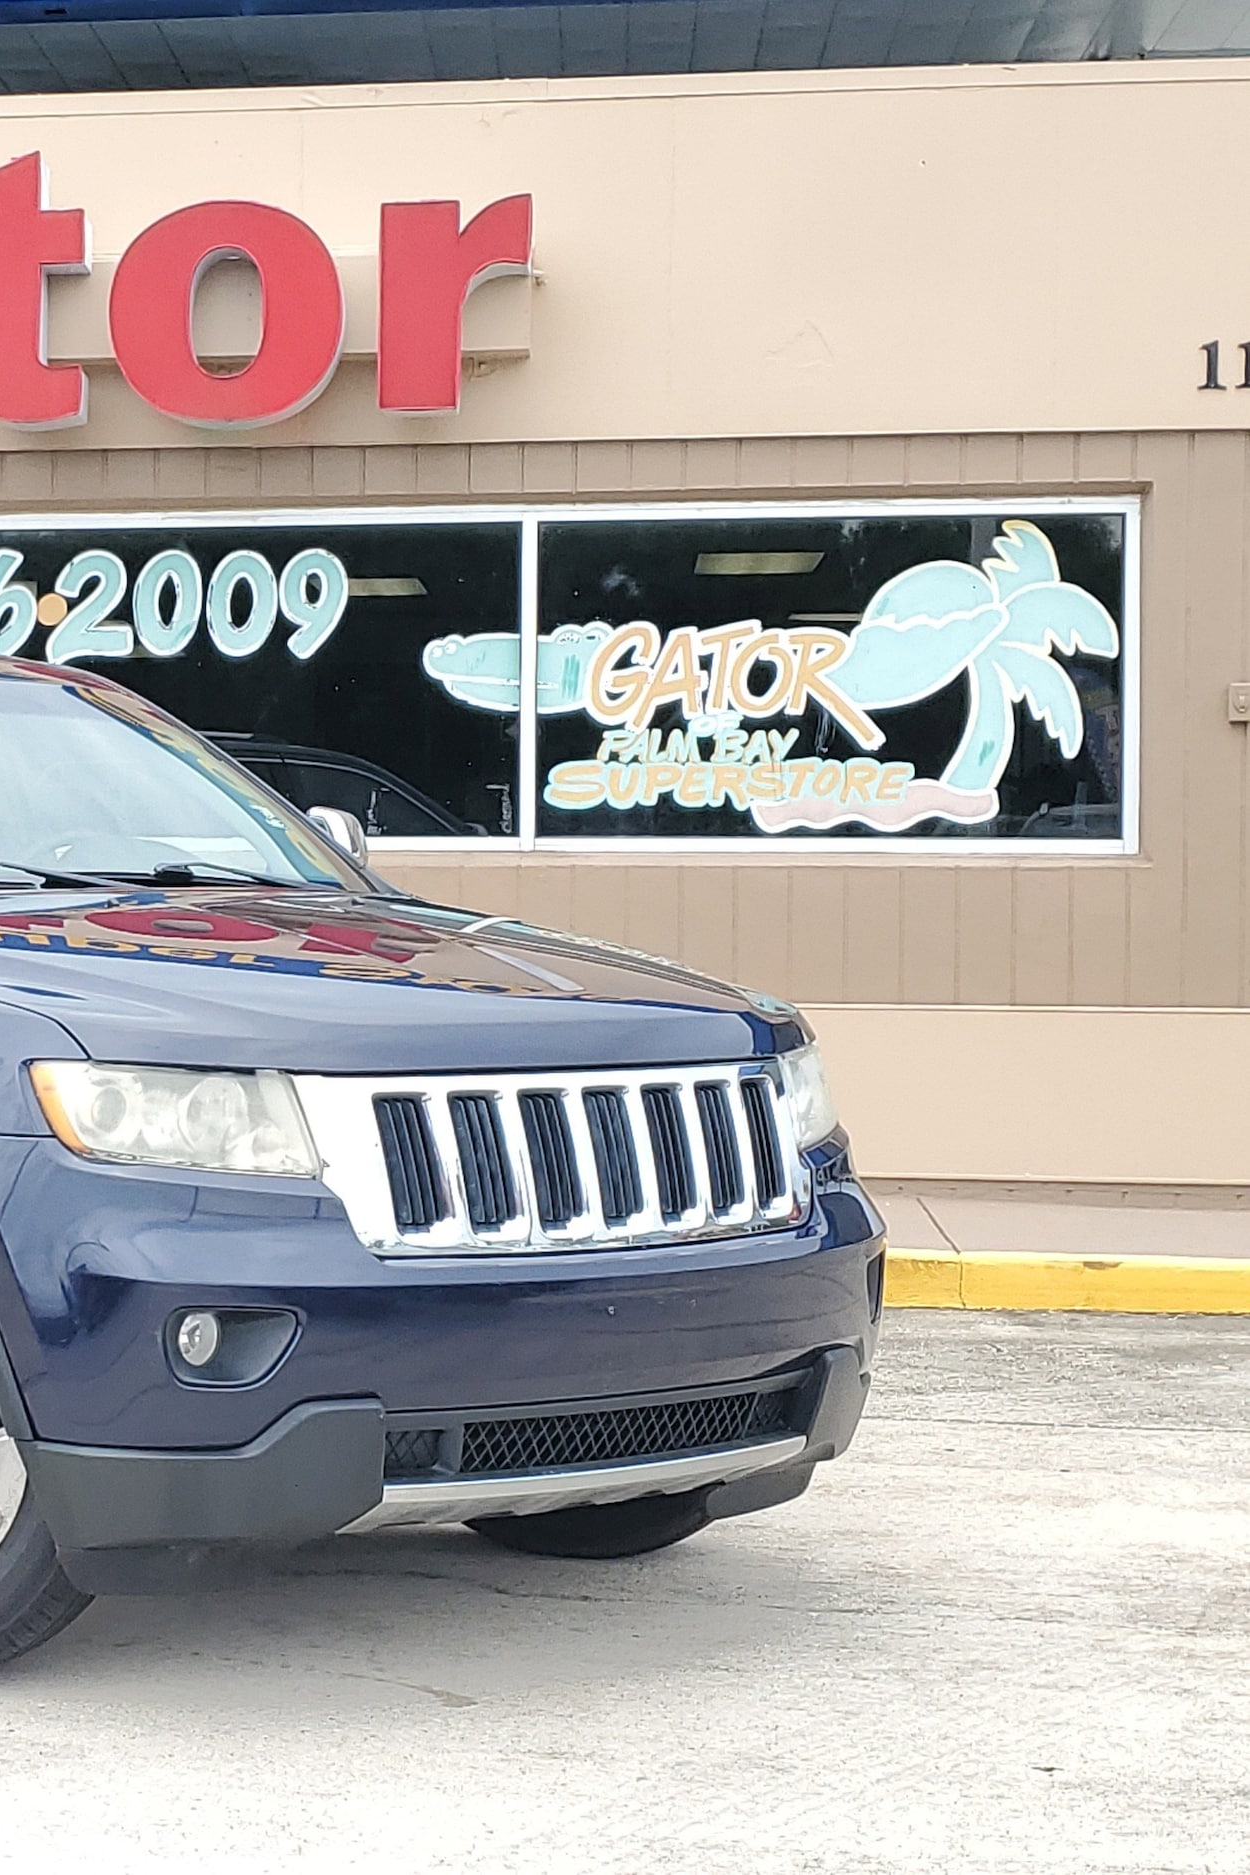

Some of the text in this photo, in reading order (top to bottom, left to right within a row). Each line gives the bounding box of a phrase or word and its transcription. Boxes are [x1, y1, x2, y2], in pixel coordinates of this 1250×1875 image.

[587, 619, 887, 752] GATOR
[597, 727, 800, 764] PALM BAY
[688, 709, 744, 738] OF
[544, 757, 915, 810] SUPERSTORE
